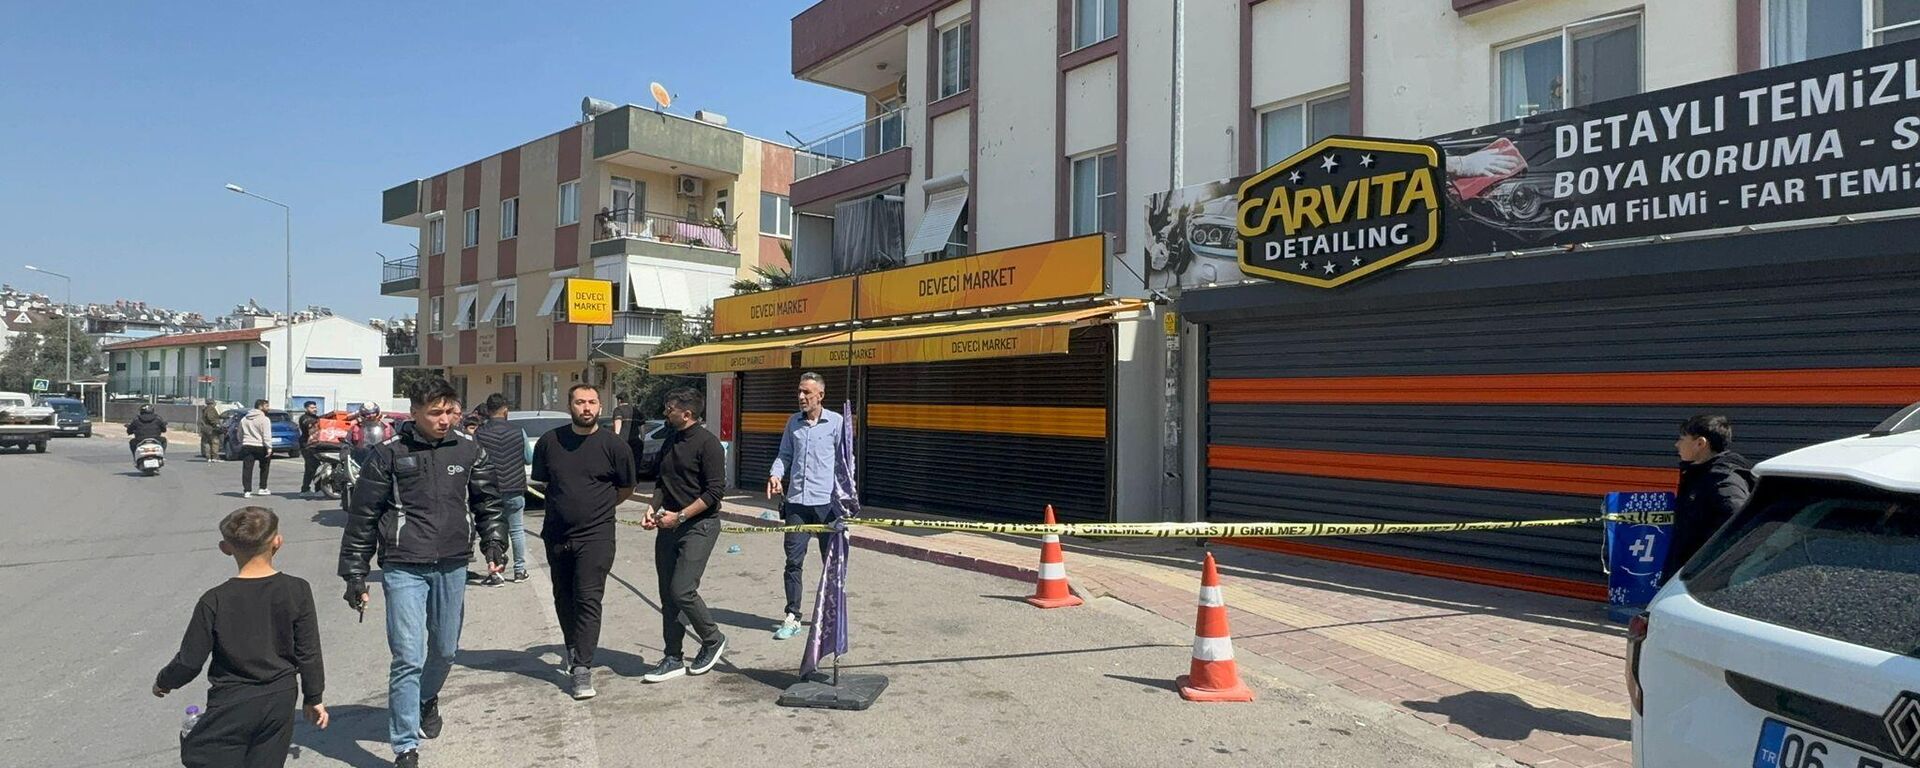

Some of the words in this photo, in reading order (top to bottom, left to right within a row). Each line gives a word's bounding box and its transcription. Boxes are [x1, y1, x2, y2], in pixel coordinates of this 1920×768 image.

[1555, 95, 1725, 159] DETAYLI
[1553, 159, 1648, 199] BOYA
[1660, 128, 1844, 184] KORUMA
[1236, 167, 1439, 238] CARVITA
[1553, 202, 1617, 232] CAM
[1740, 177, 1805, 209] FAR
[1264, 223, 1409, 261] DETAILING
[963, 265, 1016, 291] MARKET
[573, 302, 607, 312] MARKET
[777, 298, 808, 316] MARKET
[981, 336, 1018, 352] MARKET
[1628, 534, 1656, 562] +1
[1760, 748, 1777, 765] TR
